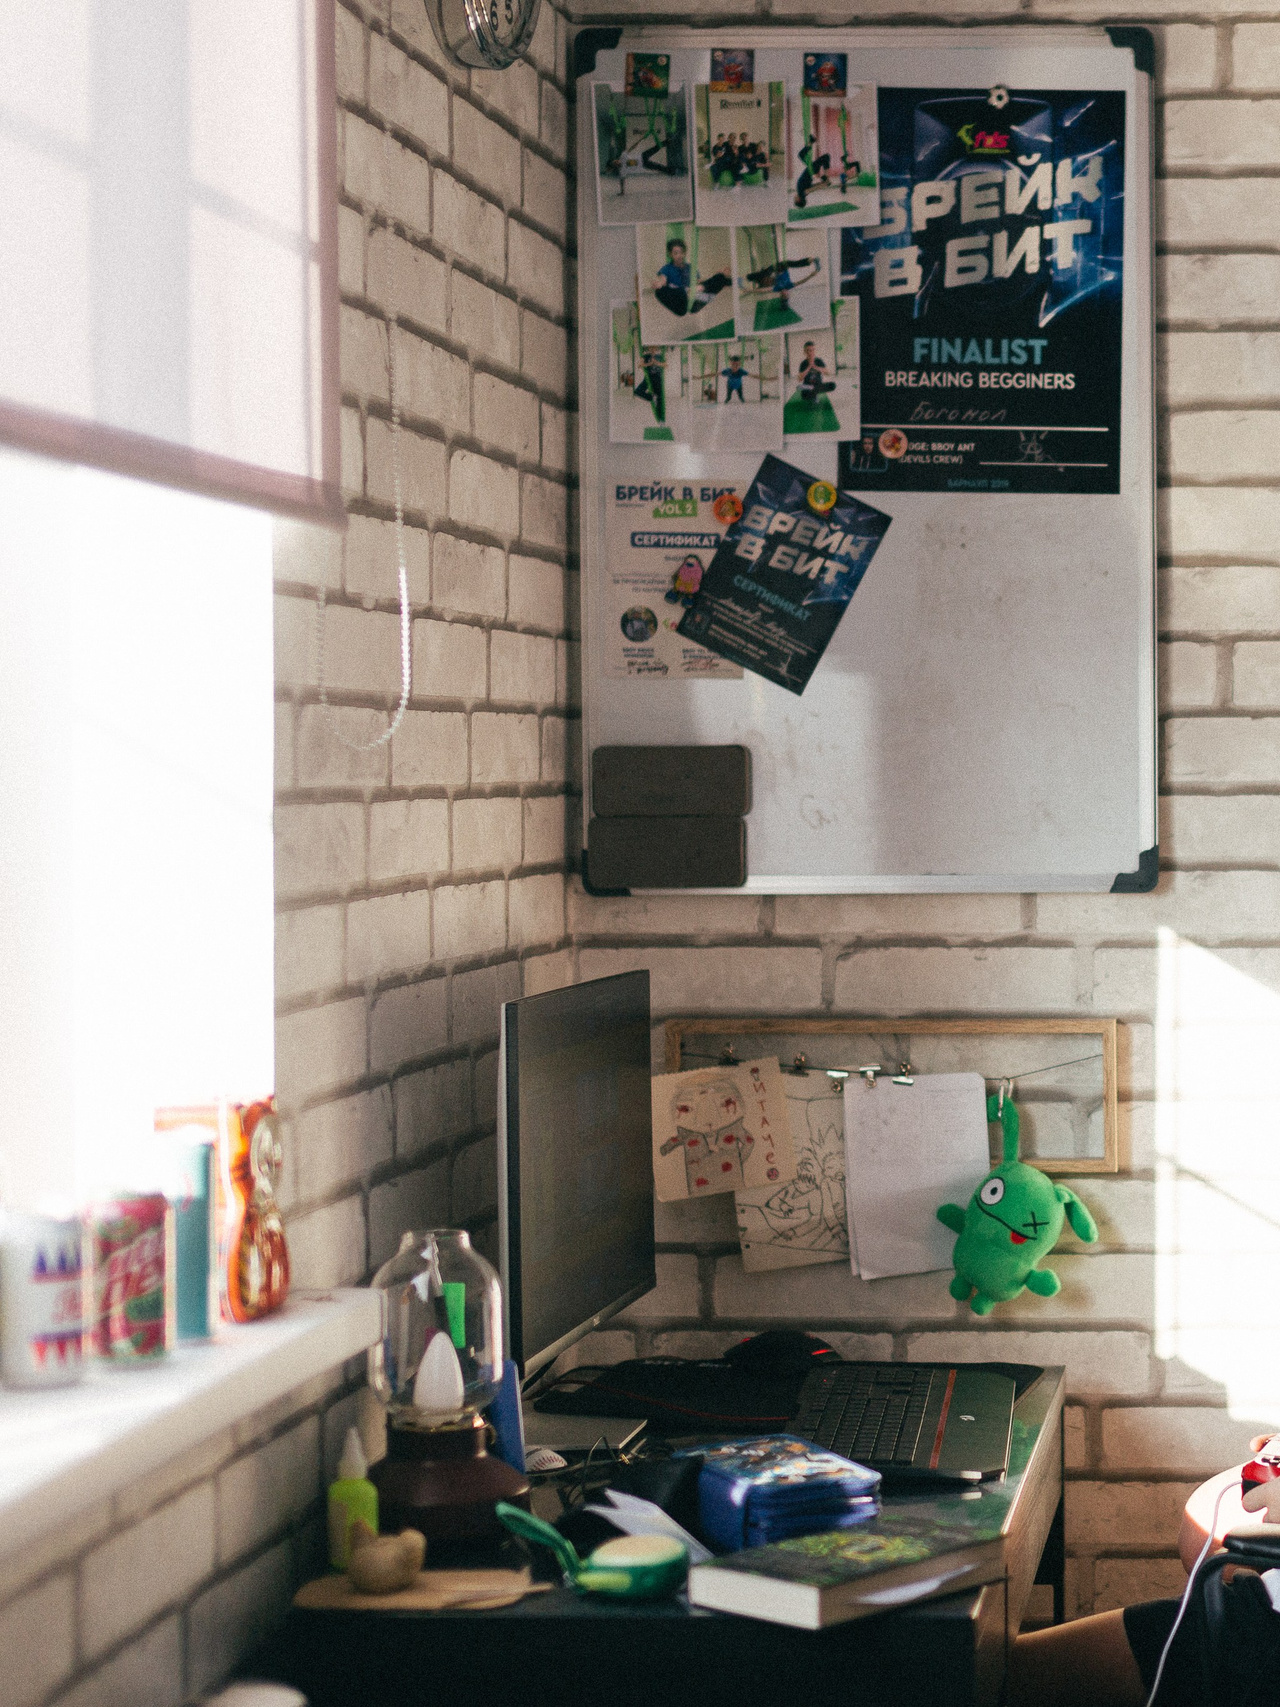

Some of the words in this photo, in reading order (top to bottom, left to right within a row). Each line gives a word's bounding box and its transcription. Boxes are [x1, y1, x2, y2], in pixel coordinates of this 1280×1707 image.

[863, 153, 1103, 239] БРЕЙК
[873, 245, 923, 298] В
[944, 219, 1092, 288] БИТ
[913, 337, 1048, 365] FINALIST
[885, 371, 973, 388] BREAKING
[978, 372, 1076, 390] BEGGINERS
[616, 481, 676, 501] БРЕЙК
[682, 486, 694, 501] В
[658, 503, 683, 515] VOL
[686, 503, 694, 514] 2
[633, 534, 717, 547] СЕРТИФИКАТ
[743, 504, 869, 560] БРЕЙК
[735, 533, 765, 562] В
[768, 545, 848, 584] БИТ
